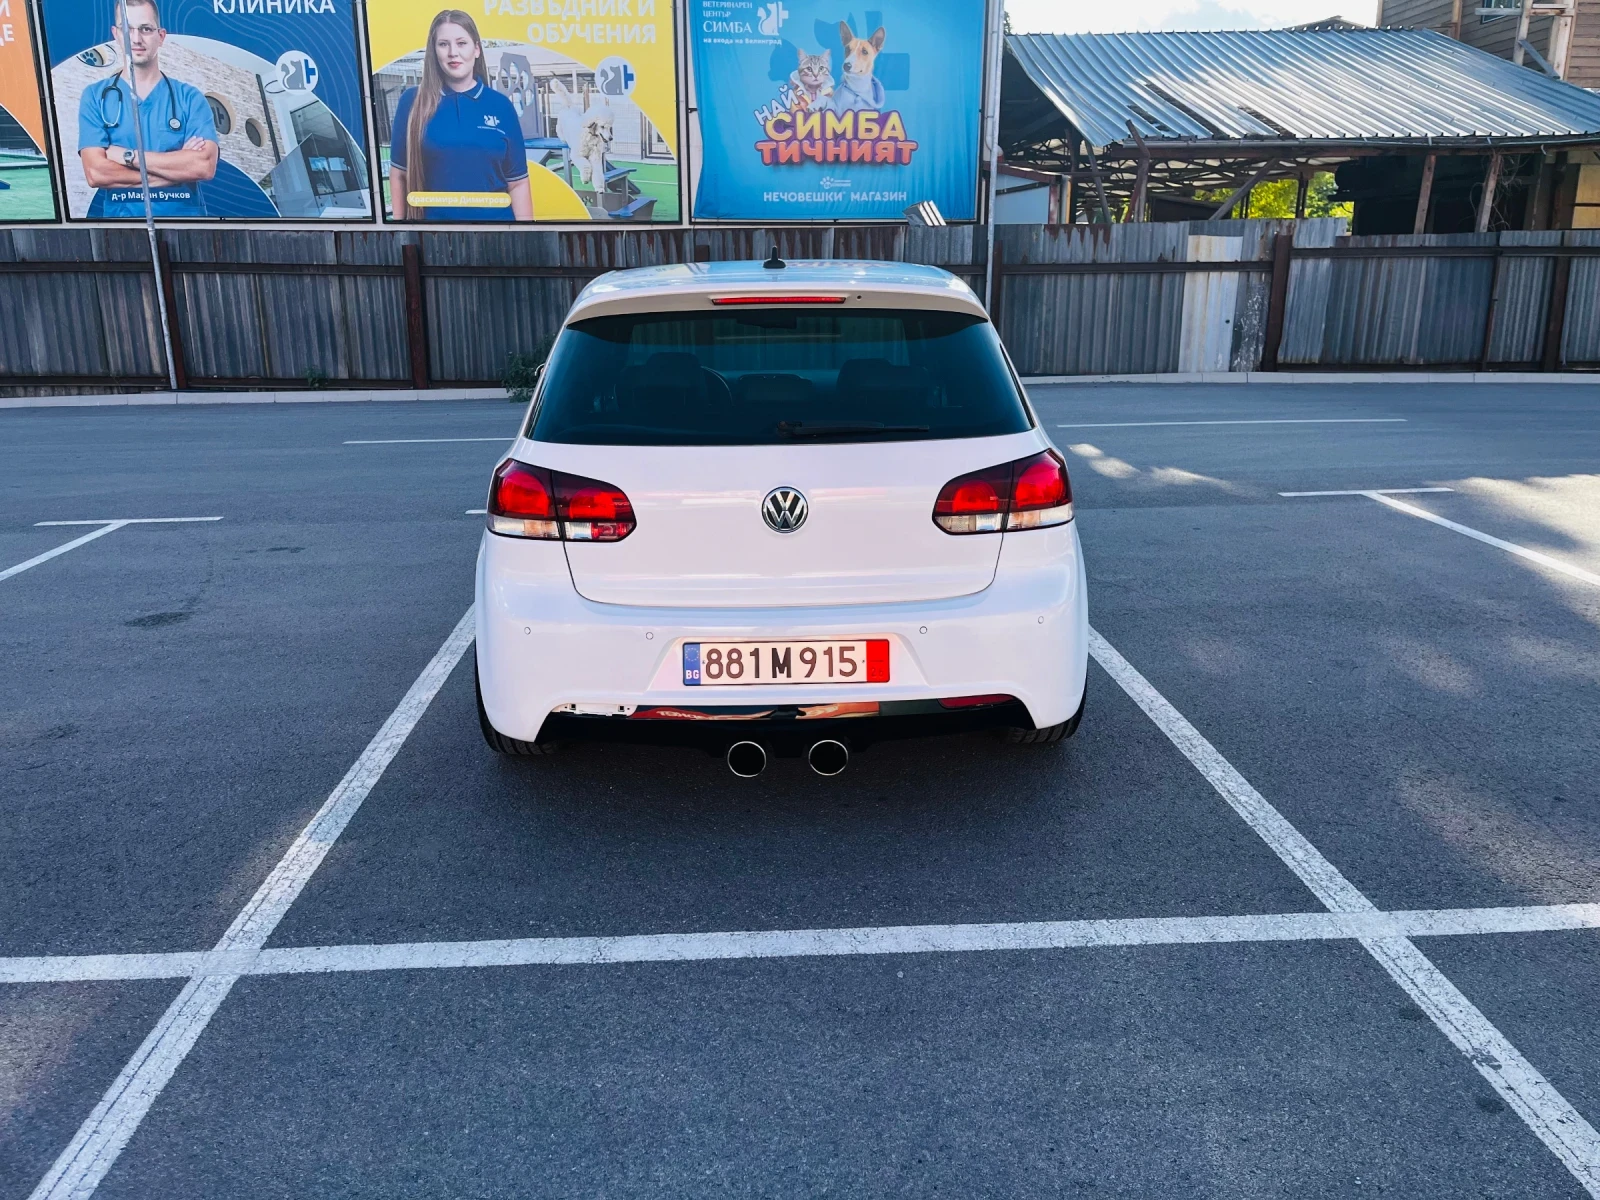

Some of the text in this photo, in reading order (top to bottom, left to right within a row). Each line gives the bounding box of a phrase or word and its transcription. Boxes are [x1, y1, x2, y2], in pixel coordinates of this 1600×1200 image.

[213, 0, 337, 13] КЛИНИКА
[484, 0, 655, 20] РАЗВЪДНИК И
[703, 20, 752, 33] СИМБА
[527, 23, 656, 44] ОБУЧЕНИЯ
[764, 110, 907, 141] СИМБА
[755, 140, 918, 165] ТИЧНИЯТ
[112, 193, 126, 201] д-р
[159, 191, 191, 201] Бучков
[763, 191, 907, 202] НЕЧОВЕШКИ МАГАЗИН
[685, 669, 700, 680] BG
